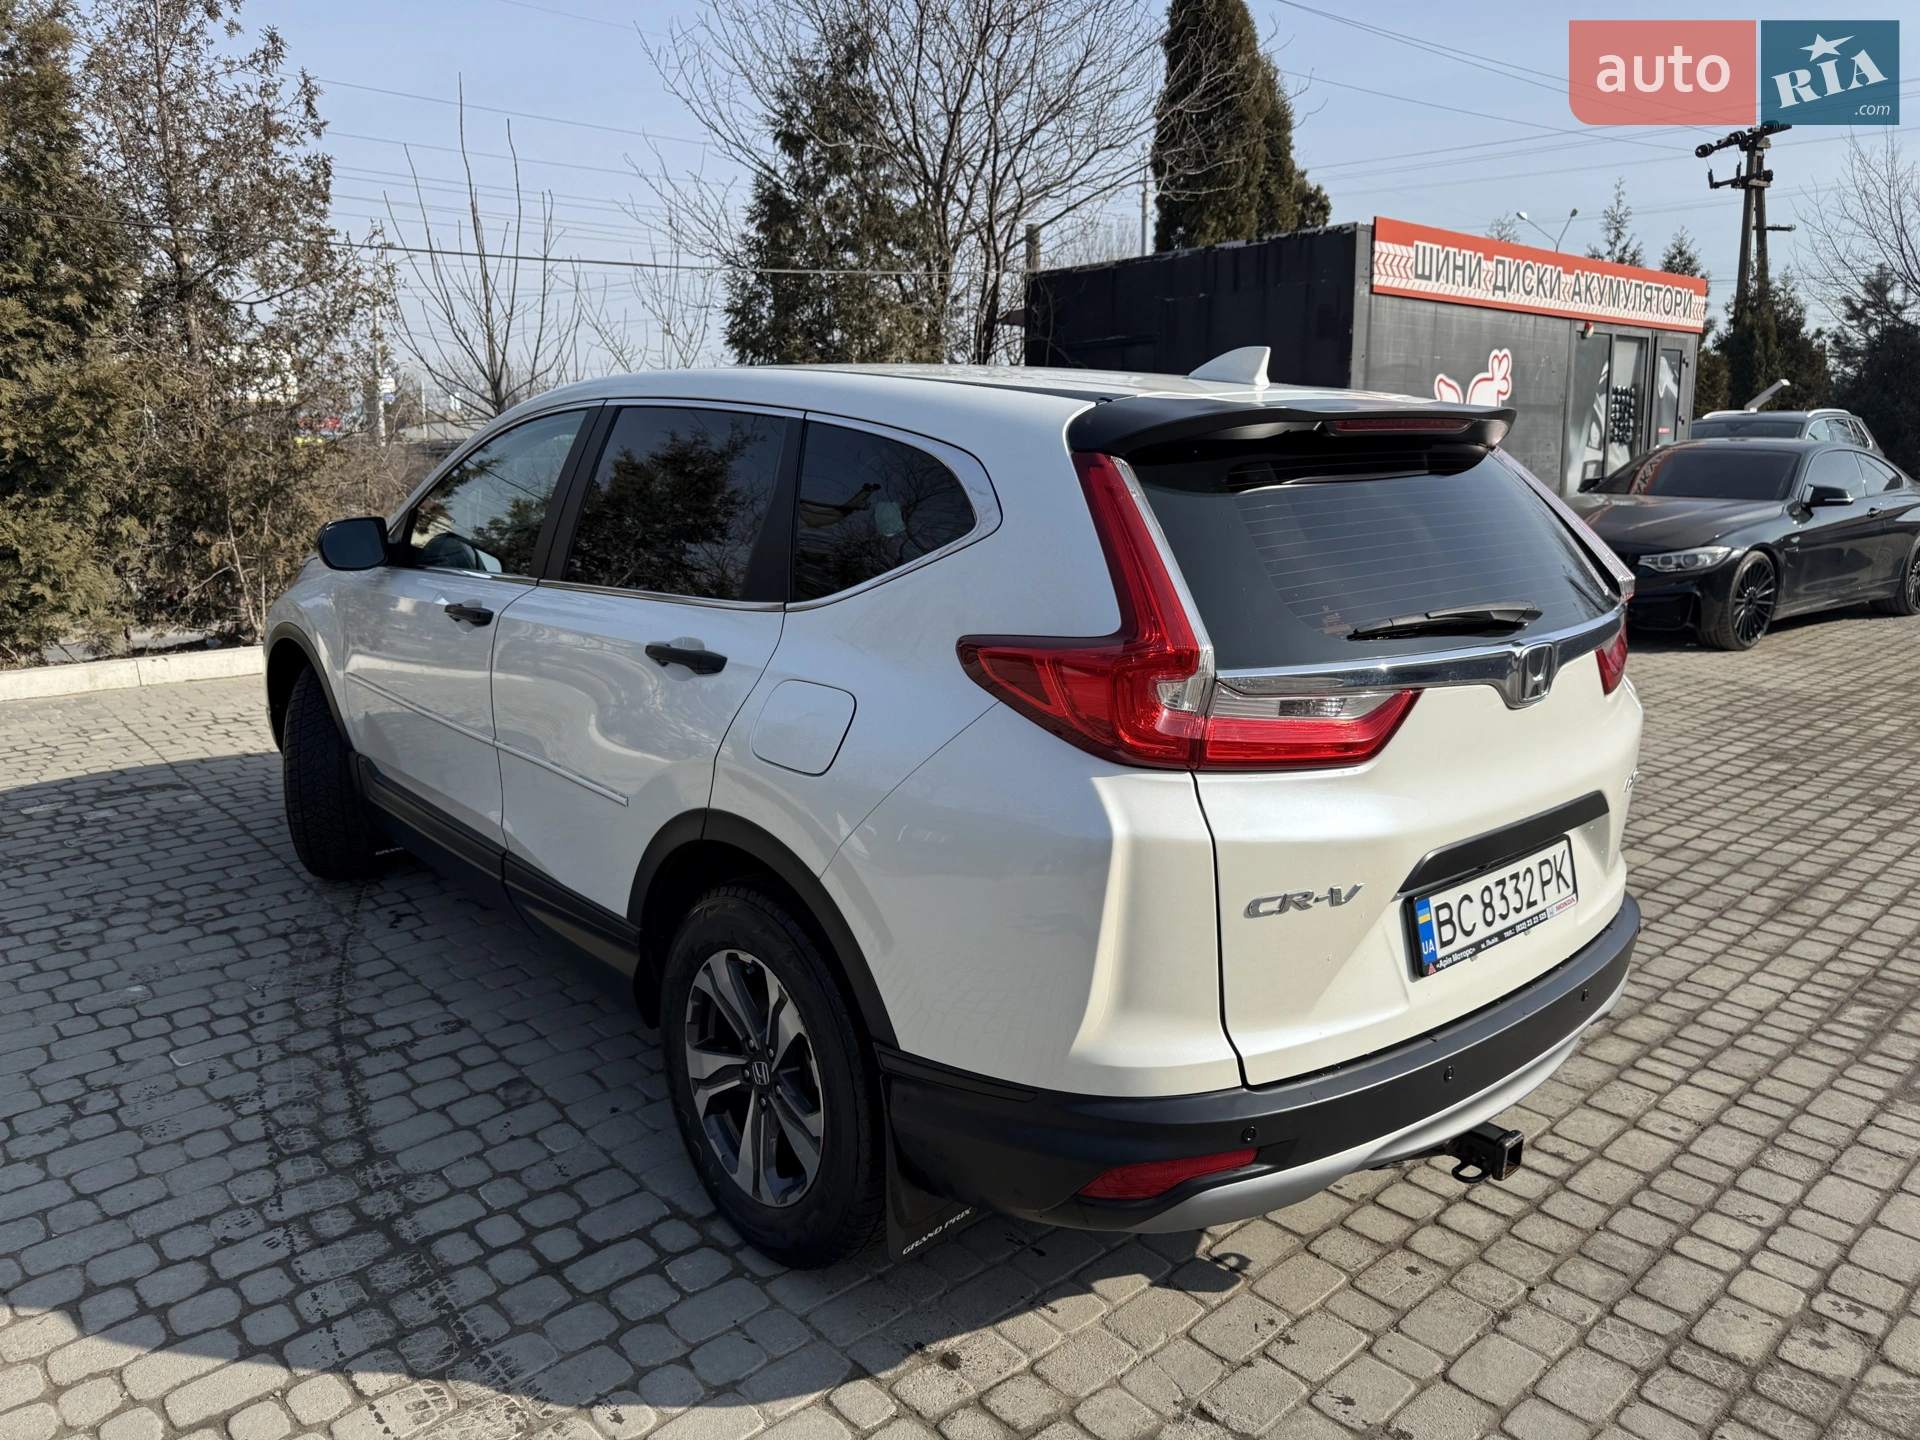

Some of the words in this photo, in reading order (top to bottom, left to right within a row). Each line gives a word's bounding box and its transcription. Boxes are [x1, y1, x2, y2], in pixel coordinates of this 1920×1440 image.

[1413, 243, 1483, 290] ШИНИ
[1491, 257, 1562, 301] ДИСКИ
[1570, 271, 1694, 320] АКУМУЛЯТОРИ
[1244, 882, 1365, 918] CR-V
[1433, 893, 1477, 950] BC
[1480, 865, 1538, 928] 8332
[1537, 848, 1571, 902] PK
[1555, 897, 1576, 912] HONDA
[1421, 938, 1436, 955] UA
[902, 1225, 943, 1255] GRAND
[944, 1206, 972, 1229] PRIX
